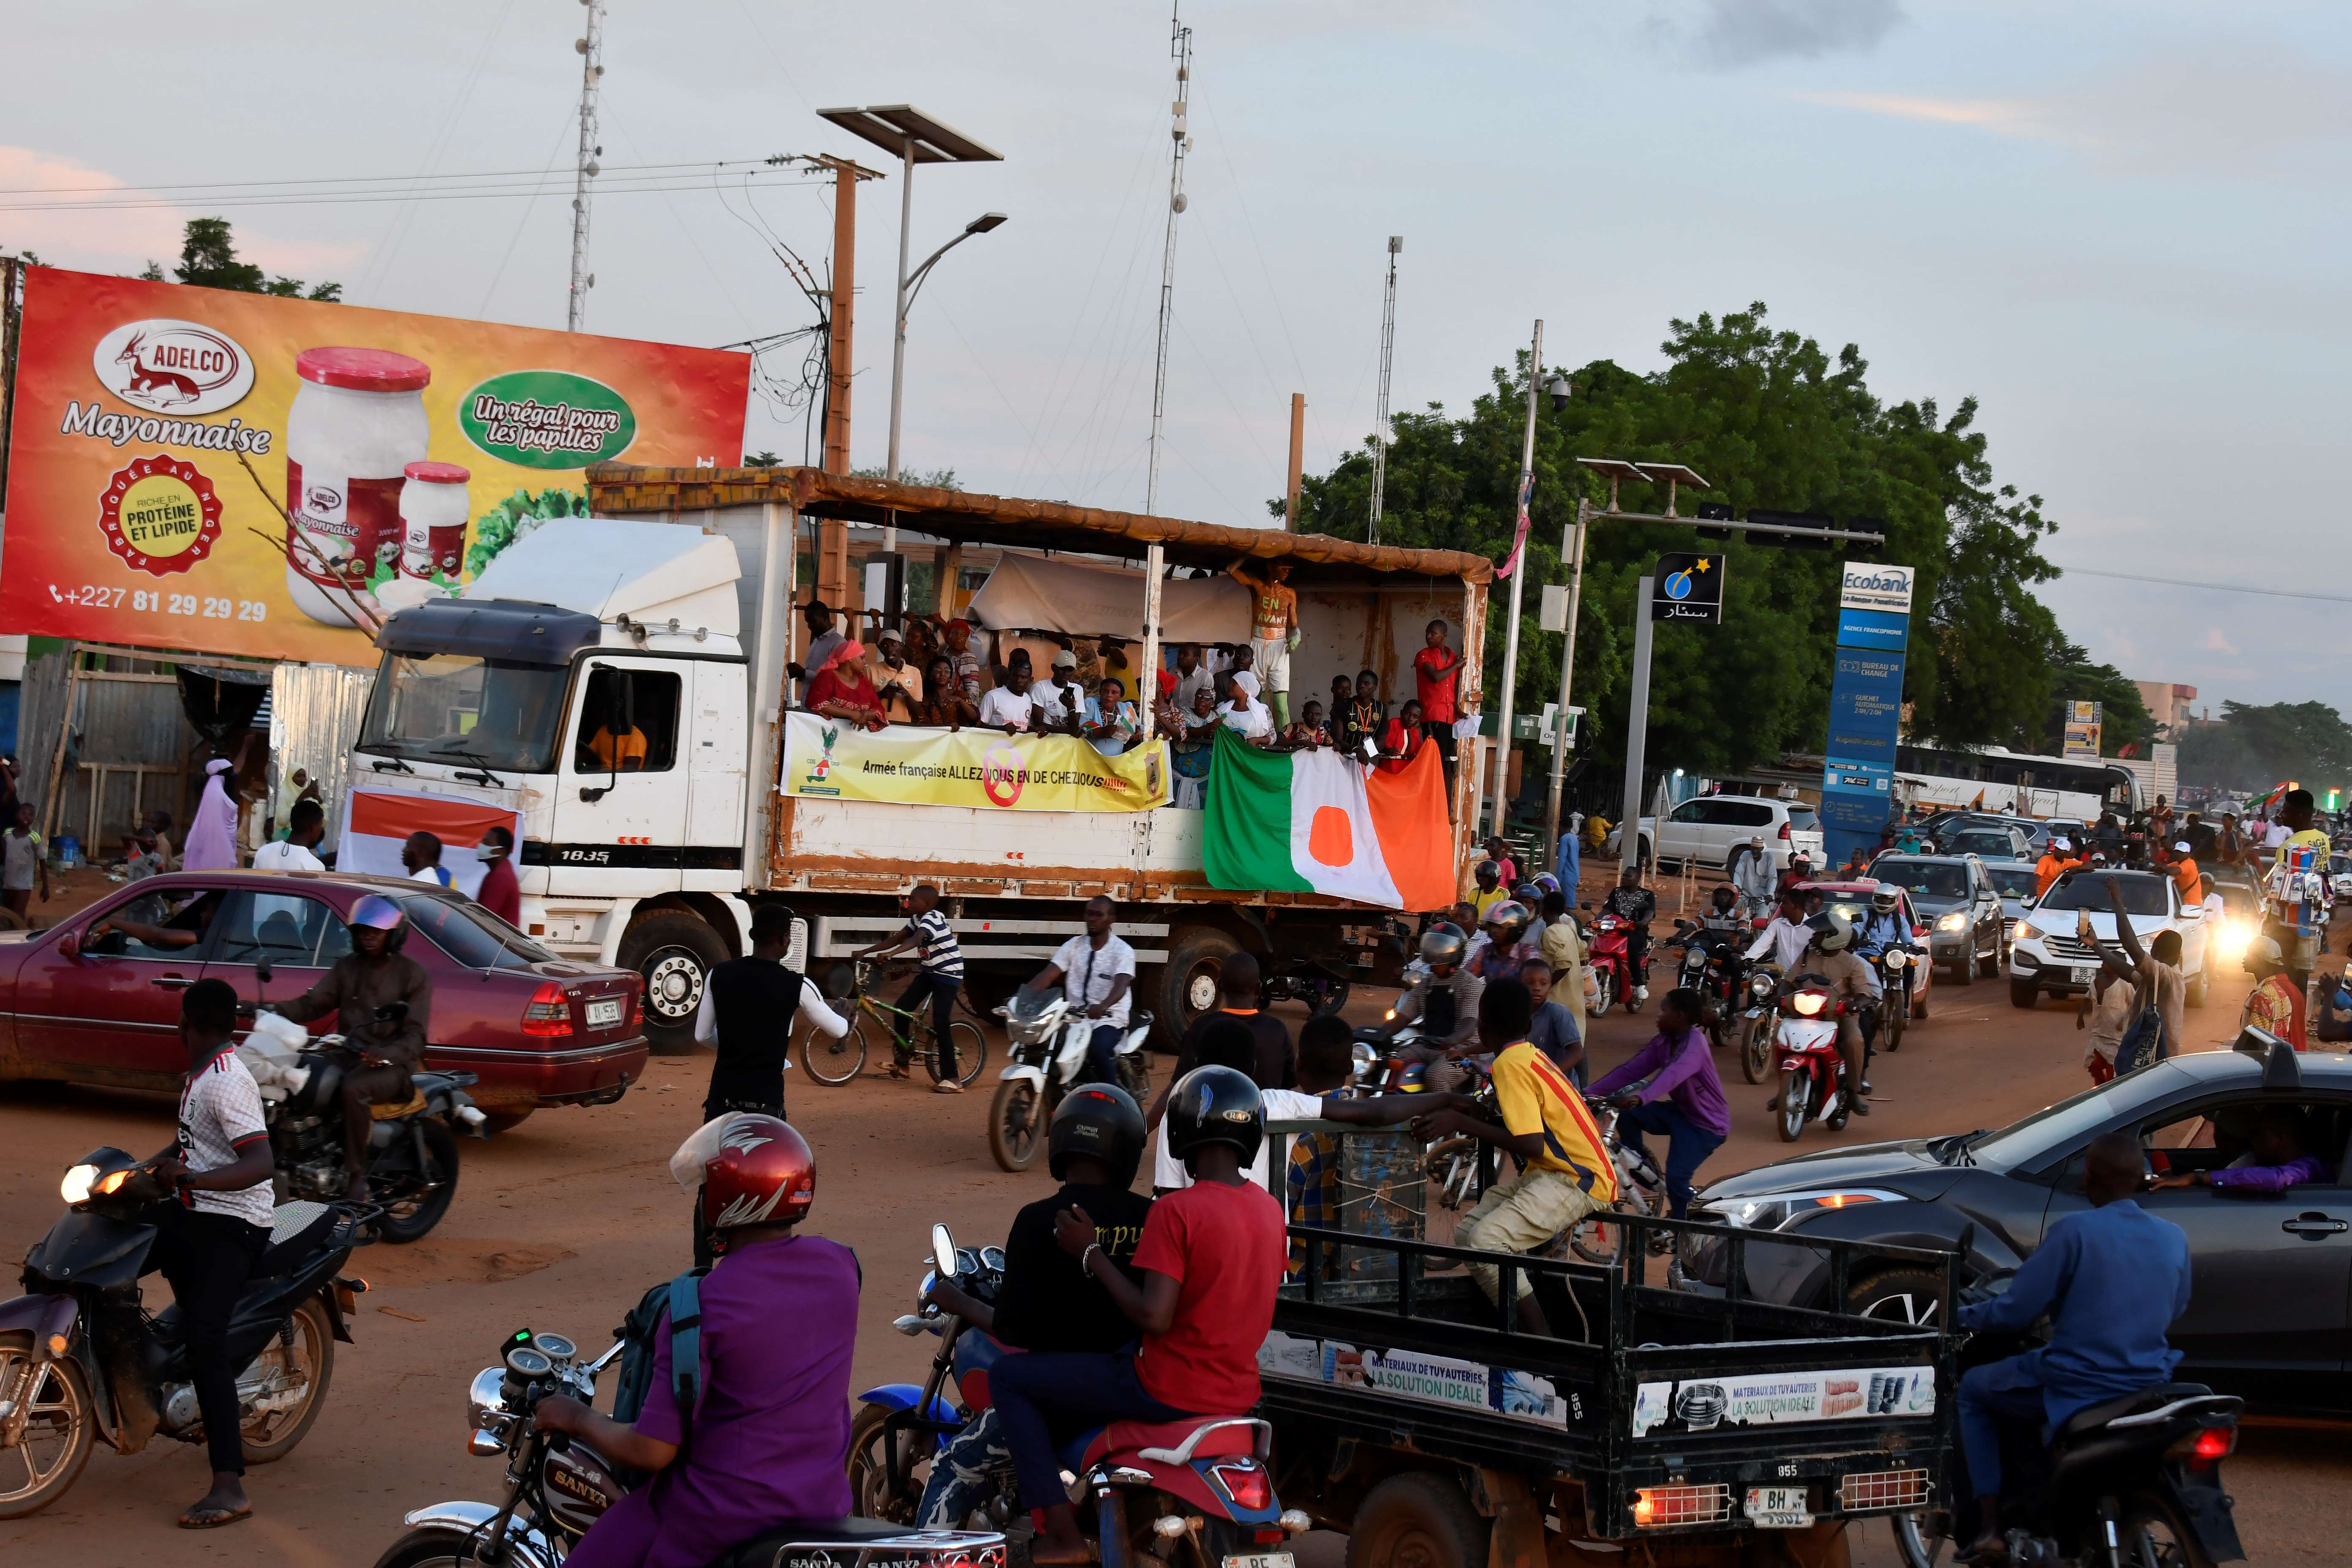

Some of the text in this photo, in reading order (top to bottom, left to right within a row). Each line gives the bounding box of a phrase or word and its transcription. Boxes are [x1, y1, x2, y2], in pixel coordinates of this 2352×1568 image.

[154, 345, 224, 373] ADELCO
[475, 395, 620, 433] Un régal pour
[61, 400, 272, 455] Mayonnaise
[487, 422, 604, 453] les papilles
[136, 494, 181, 507] RICHE EN
[316, 493, 336, 503] ADELCO
[127, 503, 196, 526] PROTÉINE
[169, 464, 193, 481] AU
[191, 491, 215, 556] NIGER
[131, 519, 197, 542] ET LIPIDE
[295, 507, 360, 537] Mayonnaise
[1843, 570, 1911, 593] Ecobank
[65, 585, 267, 622] +227 81 29 29 29
[903, 583, 909, 612] 3
[1262, 596, 1279, 610] EN
[1257, 612, 1287, 625] AVANT
[1863, 627, 1903, 636] FRANCOPHONIE
[1861, 670, 1888, 678] CHANGE
[1862, 662, 1889, 670] BUREAU
[1854, 708, 1882, 716] 24H/24H
[1855, 702, 1896, 710] AUTOMATIQUE
[863, 760, 896, 776] Armée
[898, 761, 947, 781] française
[948, 765, 983, 781] ALLEZ
[986, 767, 1014, 783] VOUS
[1017, 770, 1030, 784] EN
[1034, 770, 1048, 784] DE
[561, 850, 610, 864] 1835
[1372, 1356, 1483, 1385] MATERIAUX DE TUYAUTERIES
[1387, 1372, 1442, 1396] SOLUTION
[1445, 1382, 1482, 1404] IDEALE
[1733, 1382, 1817, 1398] MATERIAUX DE TUYAUTERIES
[1571, 1392, 1583, 1420] 855
[1732, 1396, 1816, 1416] LA SOLUTION IDEALE
[1778, 1465, 1797, 1477] 855
[555, 1470, 607, 1508] SANYA
[1767, 1490, 1786, 1509] BH
[790, 1559, 841, 1568] SANYA
[868, 1560, 920, 1568] SANYA
